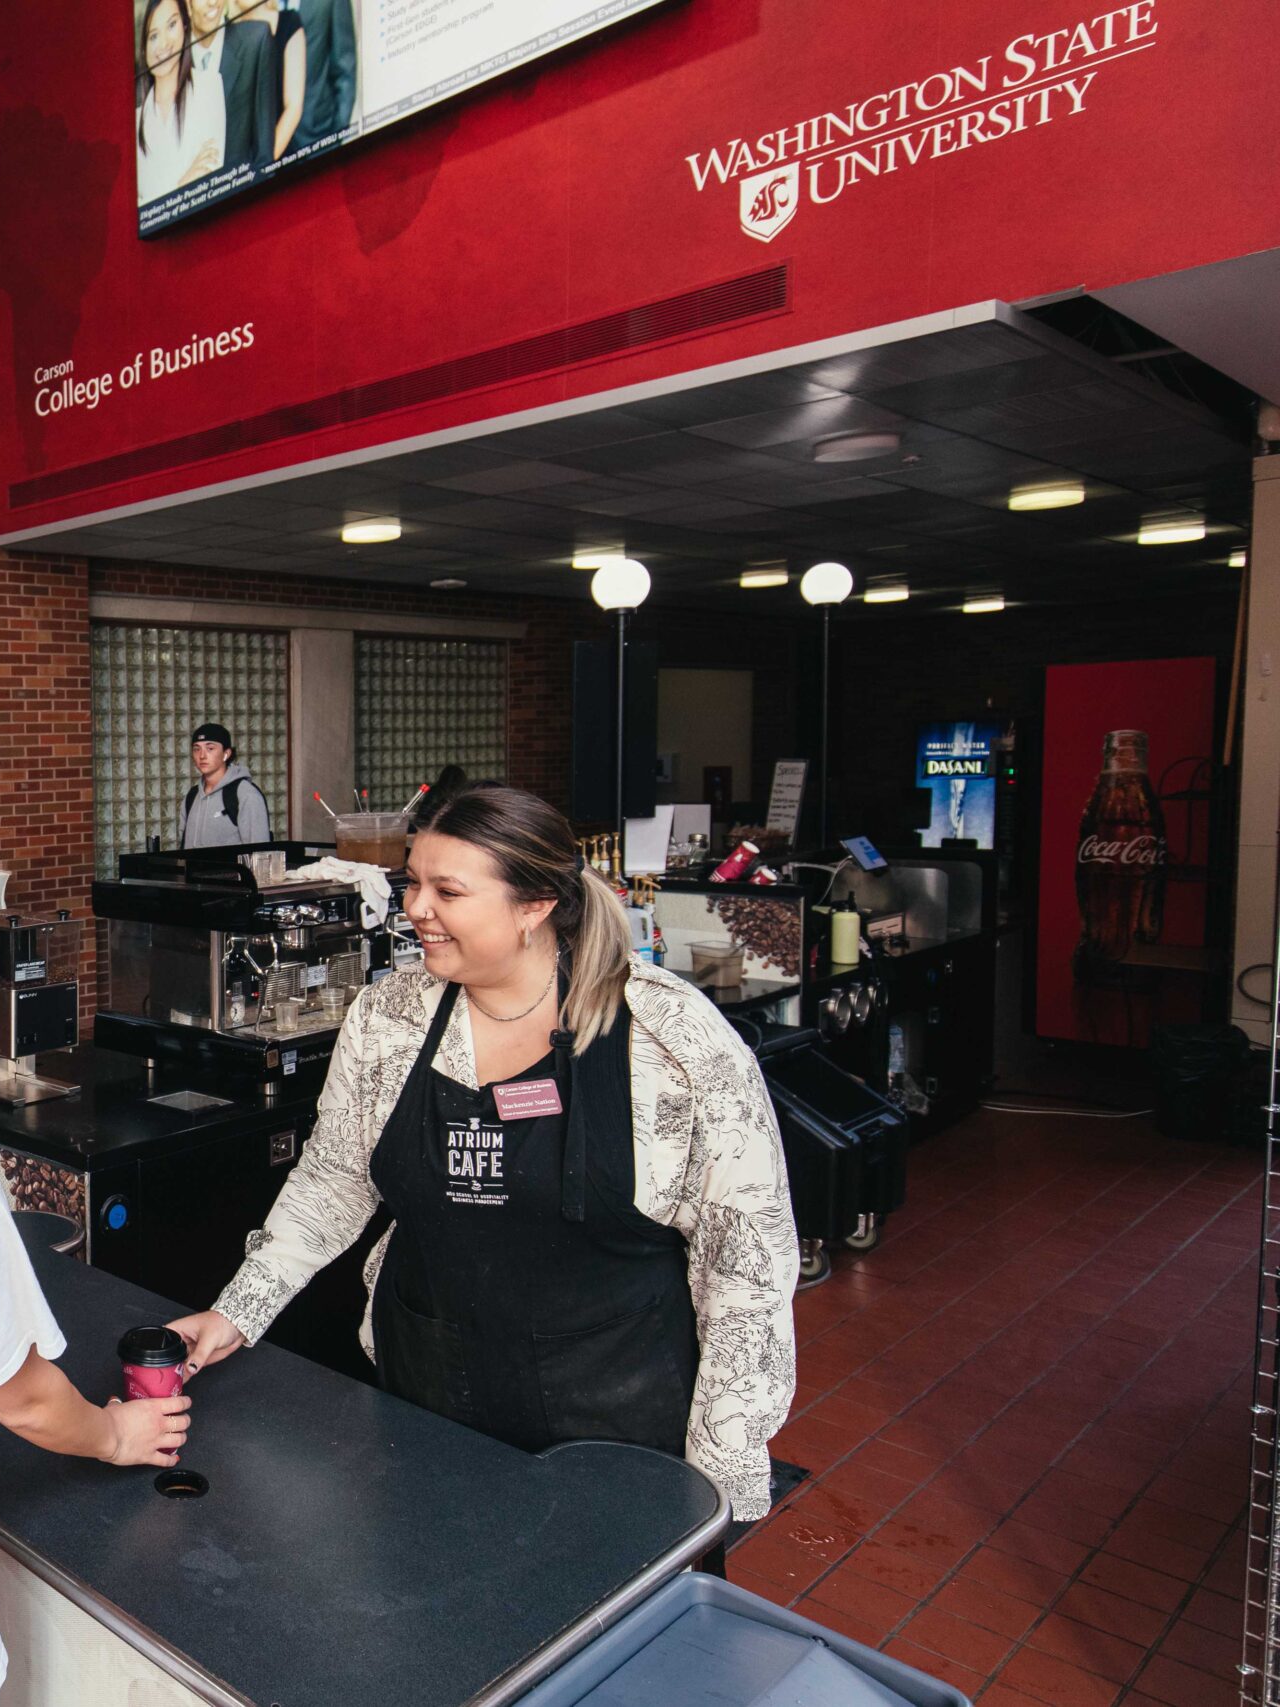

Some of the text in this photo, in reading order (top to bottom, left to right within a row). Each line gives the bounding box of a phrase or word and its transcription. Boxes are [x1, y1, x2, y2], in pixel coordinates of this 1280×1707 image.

[685, 0, 1159, 192] WASHINGTON STATE
[320, 133, 338, 147] WSU
[805, 71, 1099, 204] UNIVERSITY
[34, 322, 255, 417] College of Business
[34, 359, 74, 384] Carson
[927, 760, 982, 775] DASANI
[448, 1131, 503, 1148] ATRIUM
[448, 1149, 503, 1177] CAFE
